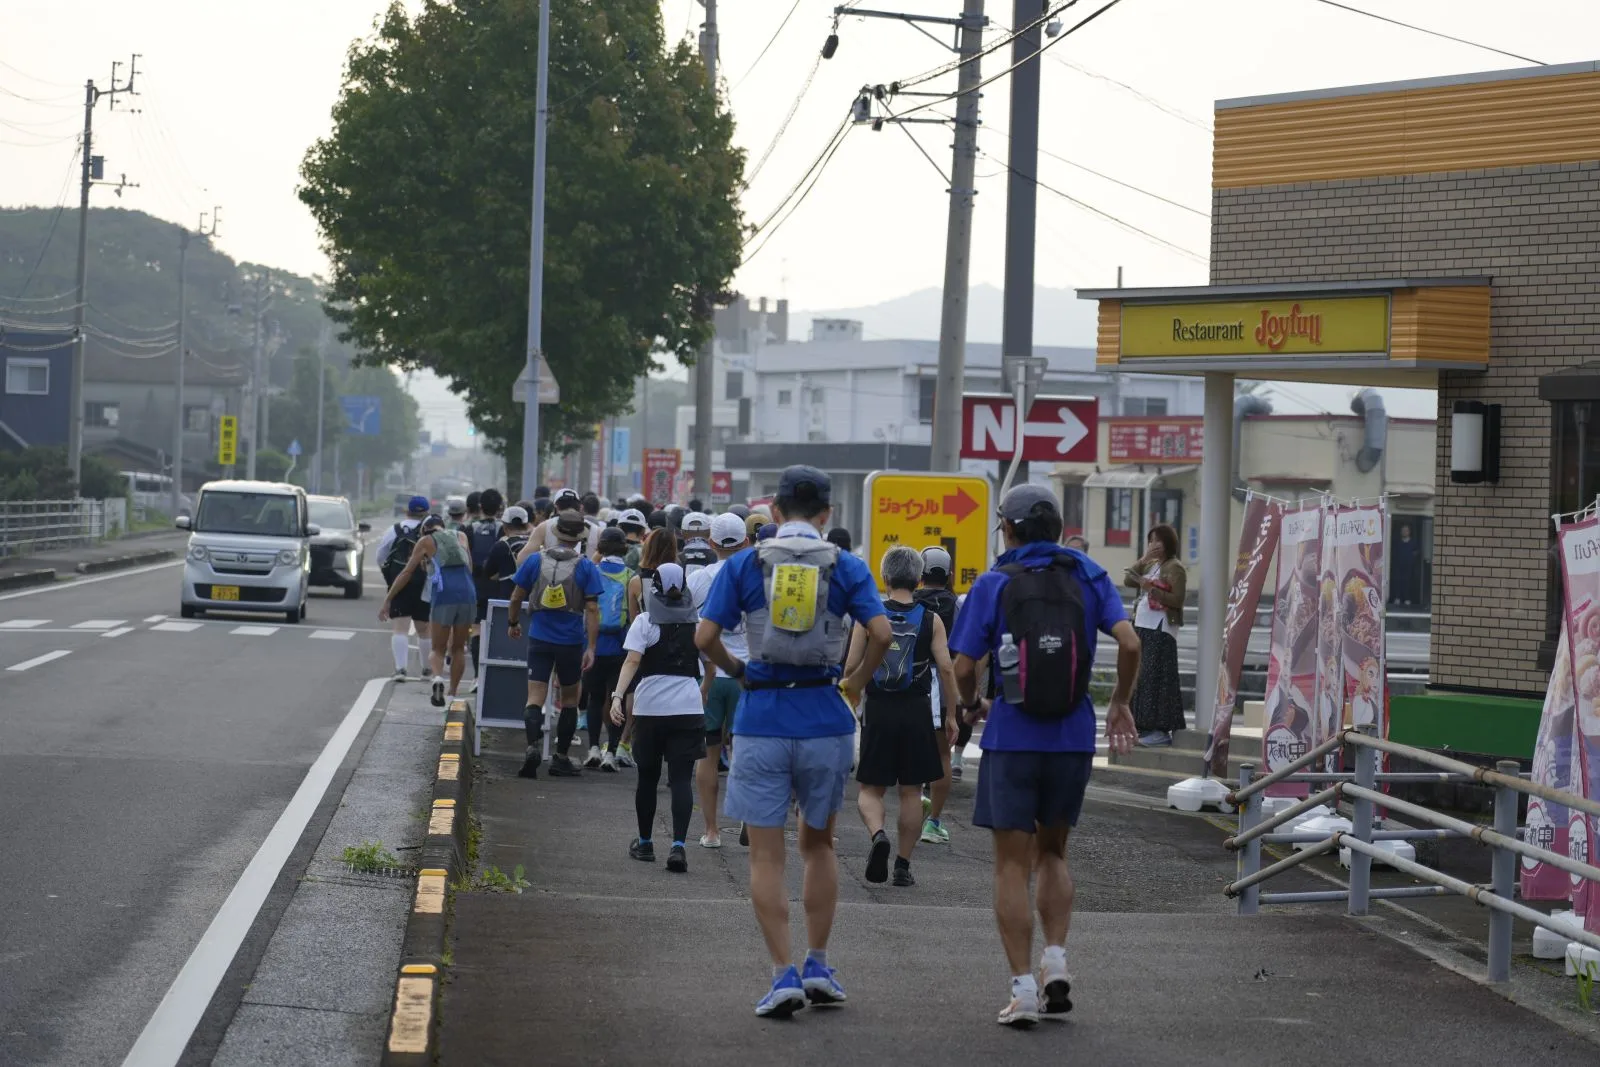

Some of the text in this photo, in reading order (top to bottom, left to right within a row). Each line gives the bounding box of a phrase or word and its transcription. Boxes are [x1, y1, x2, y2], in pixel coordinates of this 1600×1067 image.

[1173, 303, 1322, 351] Restaurant Joyfull
[879, 497, 939, 521] ジョイフル
[883, 534, 899, 543] AM
[924, 526, 942, 536] 深夜
